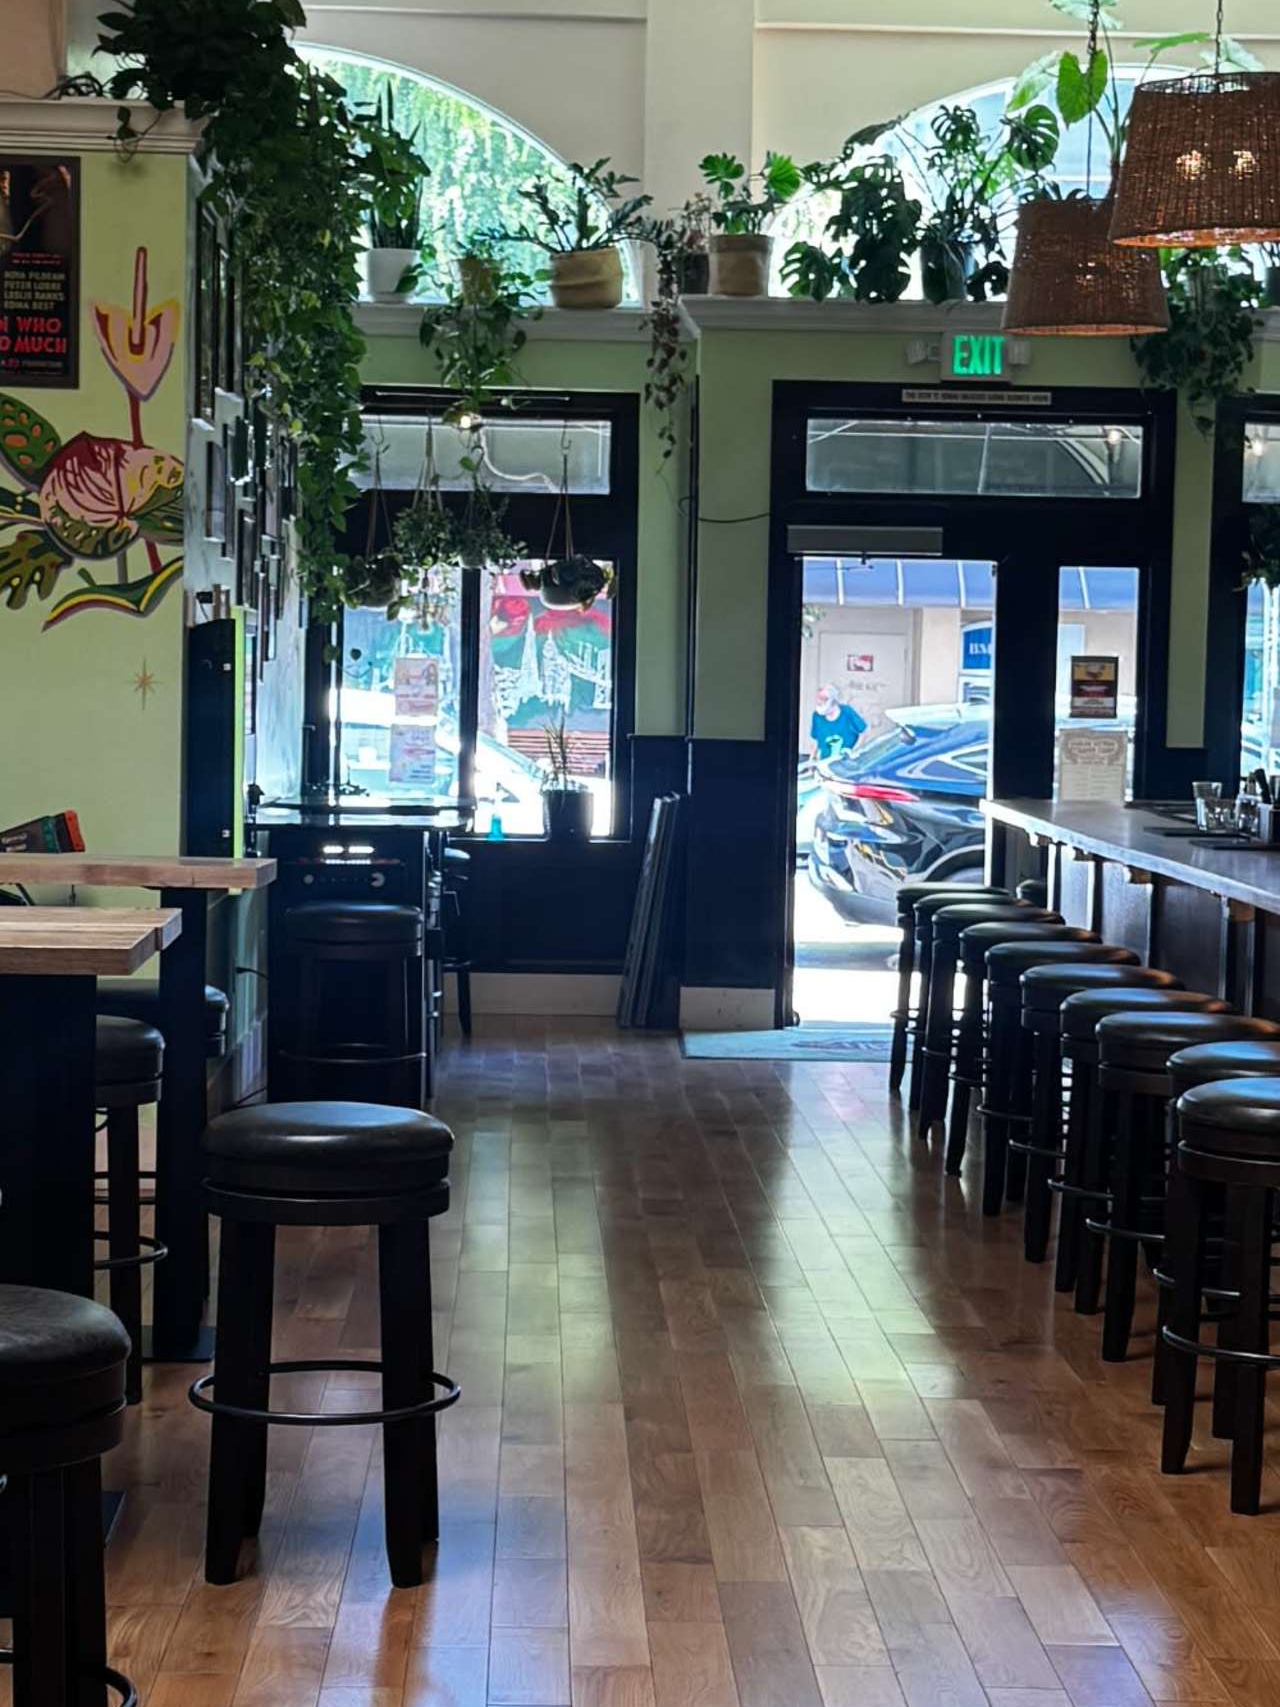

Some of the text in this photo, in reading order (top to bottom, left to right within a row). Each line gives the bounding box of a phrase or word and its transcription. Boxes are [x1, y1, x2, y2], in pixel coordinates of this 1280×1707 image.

[15, 315, 62, 334] WHO
[15, 336, 67, 354] MUCH
[952, 334, 1005, 375] EXIT
